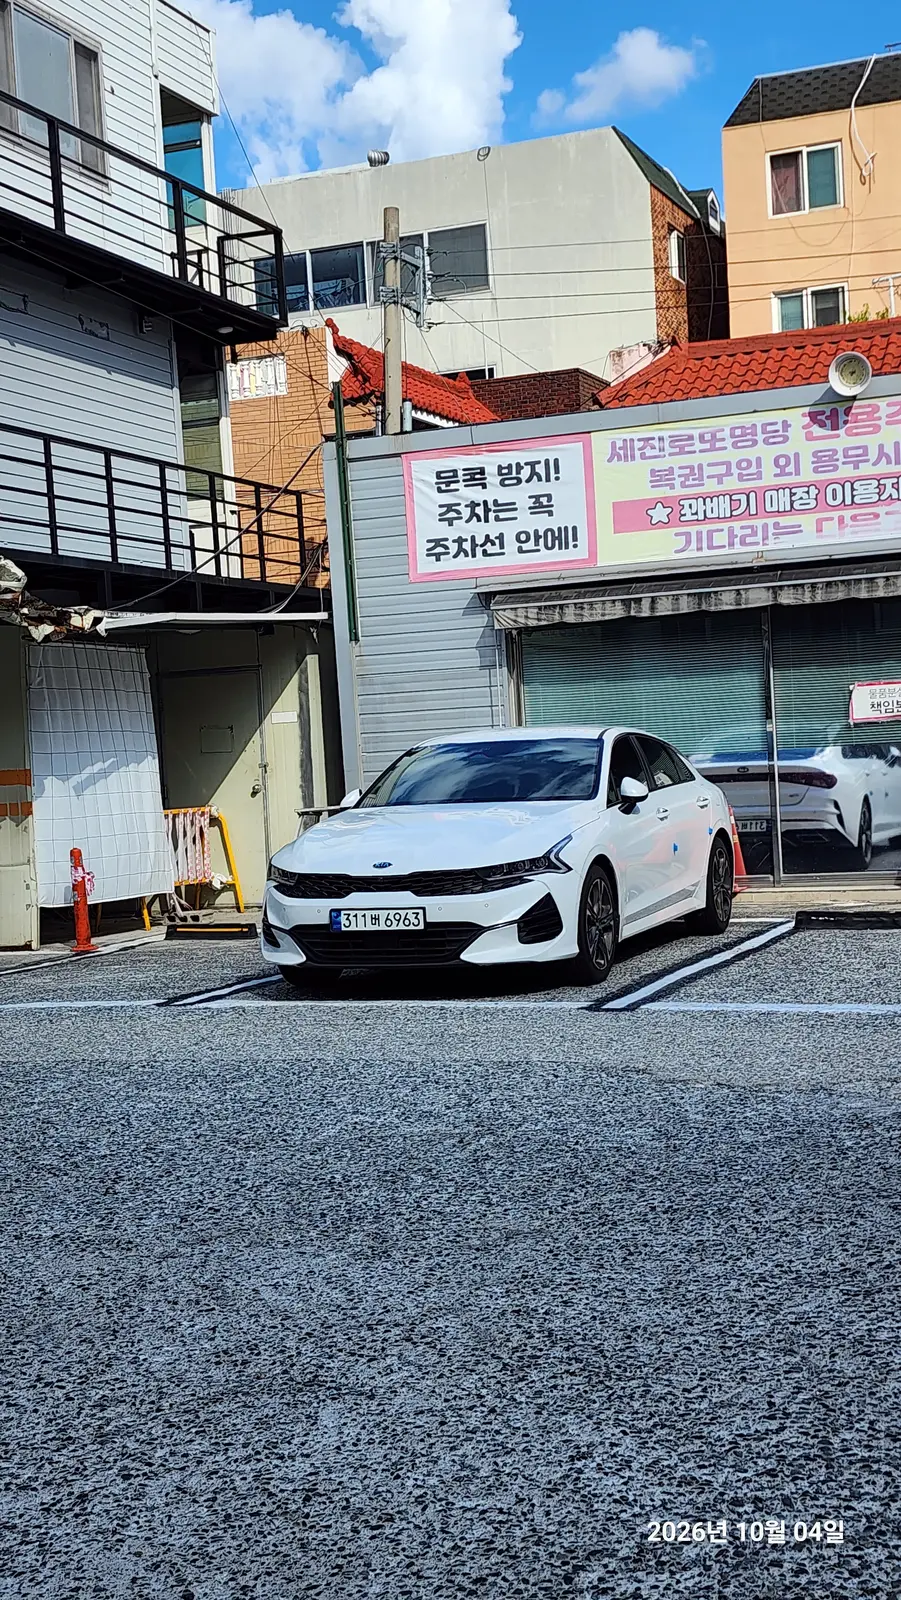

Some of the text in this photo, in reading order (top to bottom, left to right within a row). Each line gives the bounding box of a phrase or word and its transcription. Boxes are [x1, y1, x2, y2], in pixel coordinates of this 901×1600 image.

[607, 419, 792, 463] 세진로또명당
[434, 457, 561, 494] 문콕 방지!
[649, 456, 763, 490] 복권구입
[773, 451, 801, 478] 외
[438, 493, 554, 527] 주차는 꼭
[678, 490, 758, 522] 꽈배기
[764, 484, 819, 513] 매장
[425, 525, 579, 562] 주차선 안에!
[674, 521, 803, 553] 기다리는
